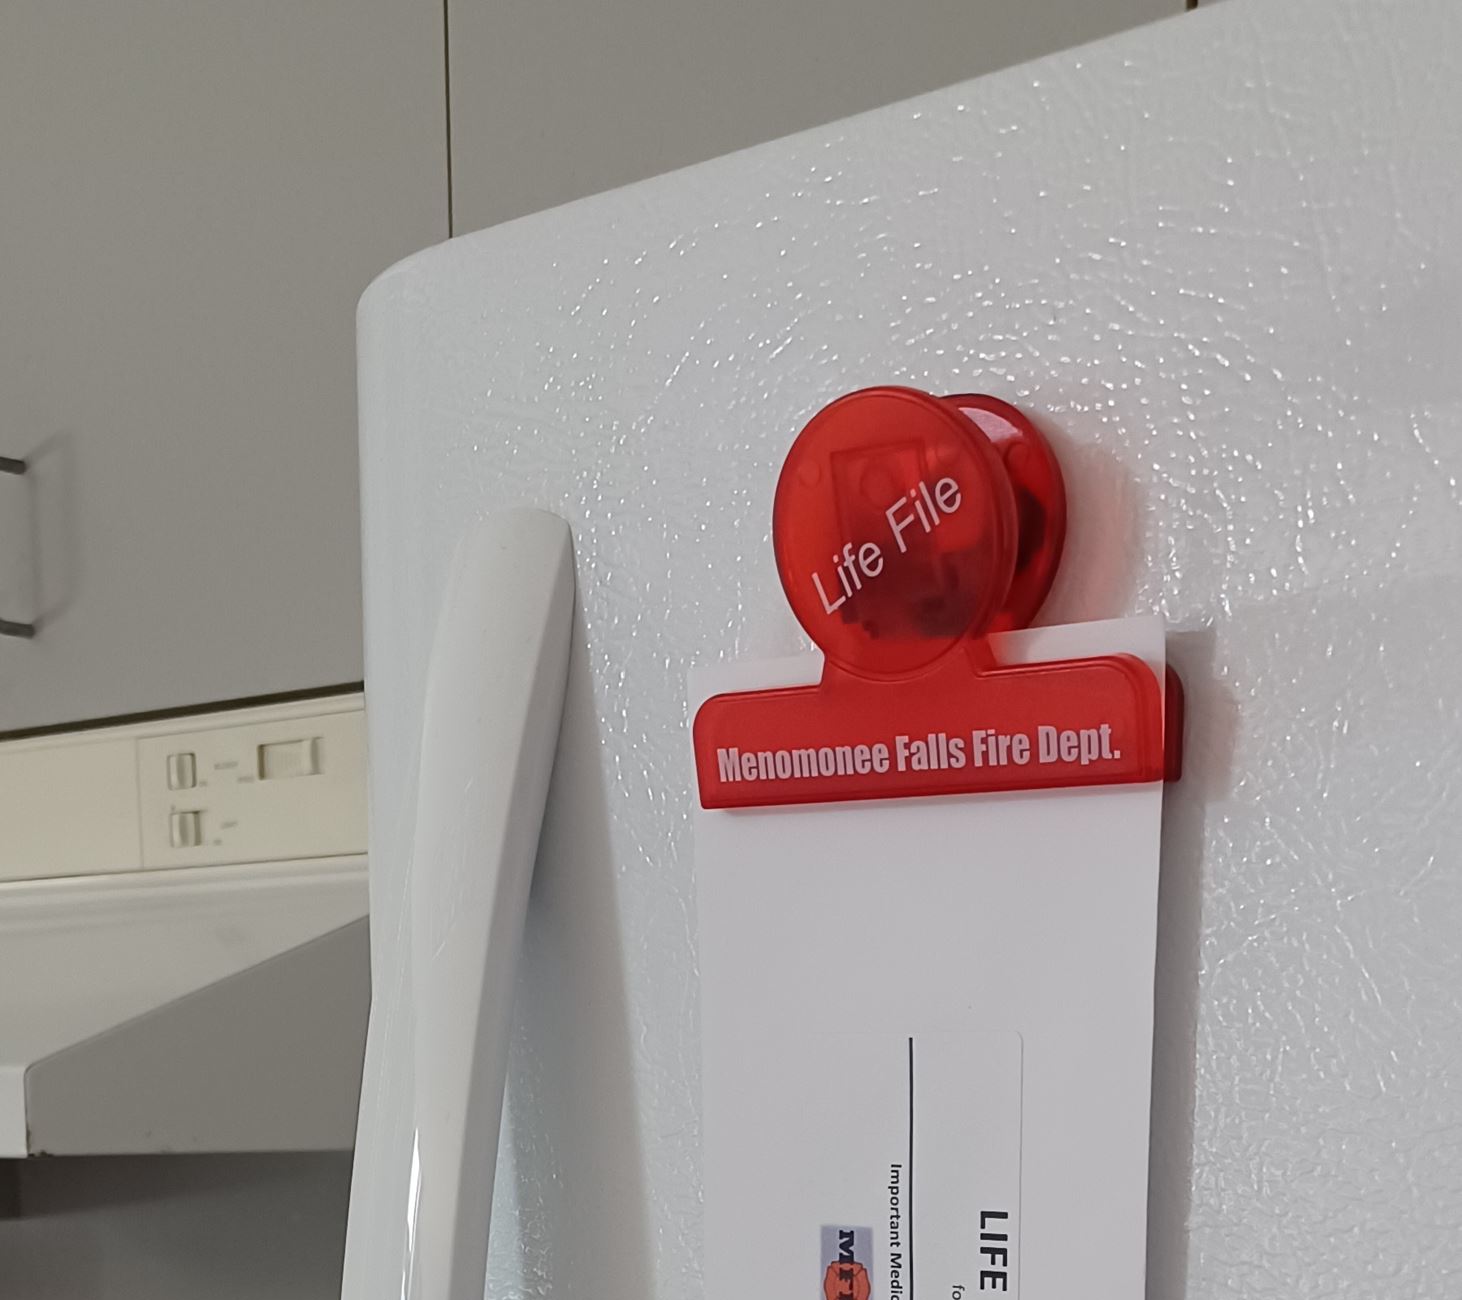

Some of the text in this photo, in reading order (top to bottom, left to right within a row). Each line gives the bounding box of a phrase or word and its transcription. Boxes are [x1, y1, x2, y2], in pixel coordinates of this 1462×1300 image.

[811, 477, 961, 615] Life File
[717, 723, 1121, 782] Menomonee Falls Fire Dept.
[888, 1163, 902, 1249] Important
[979, 1210, 1008, 1292] LIFE
